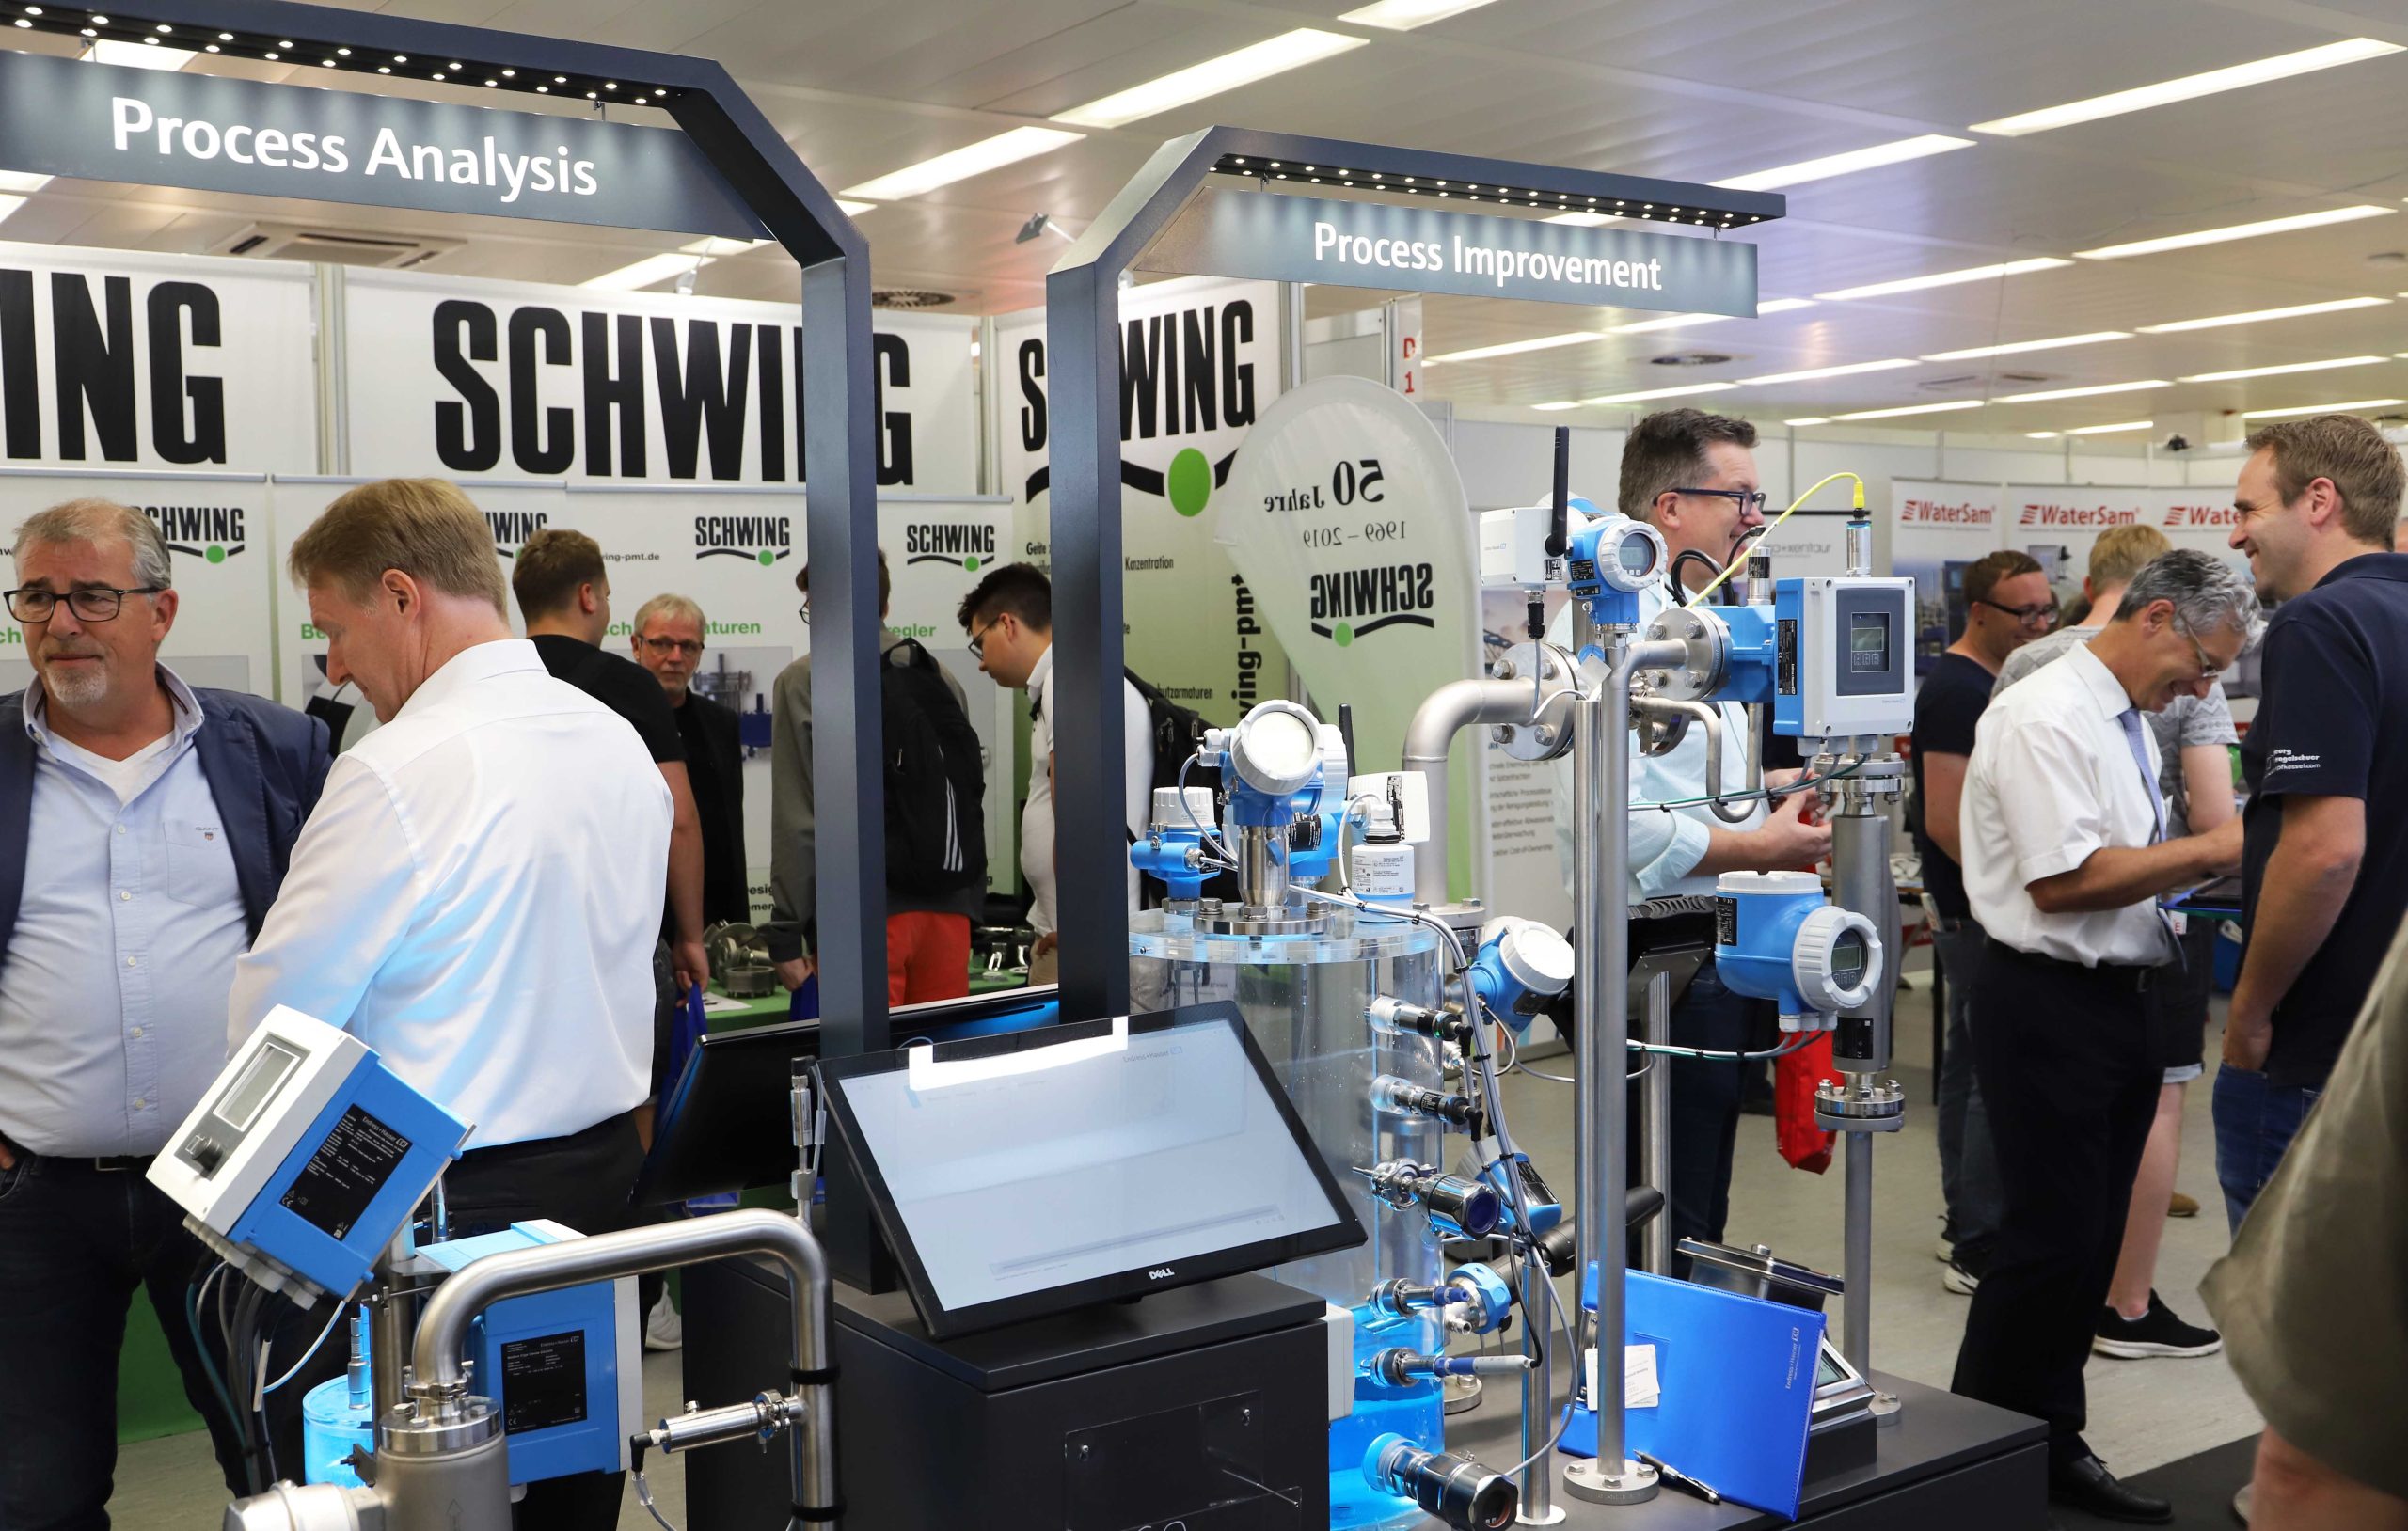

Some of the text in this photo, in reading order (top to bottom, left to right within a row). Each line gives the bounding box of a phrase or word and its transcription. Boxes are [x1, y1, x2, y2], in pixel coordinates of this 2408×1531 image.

[112, 96, 598, 203] Process Analysis
[1314, 221, 1662, 291] Process Improvement
[433, 299, 914, 486] SCHWIG
[1018, 298, 1257, 452] SWING
[695, 516, 791, 547] SCHWING
[906, 524, 995, 554] SCHWING
[1148, 1267, 1175, 1280] DELL
